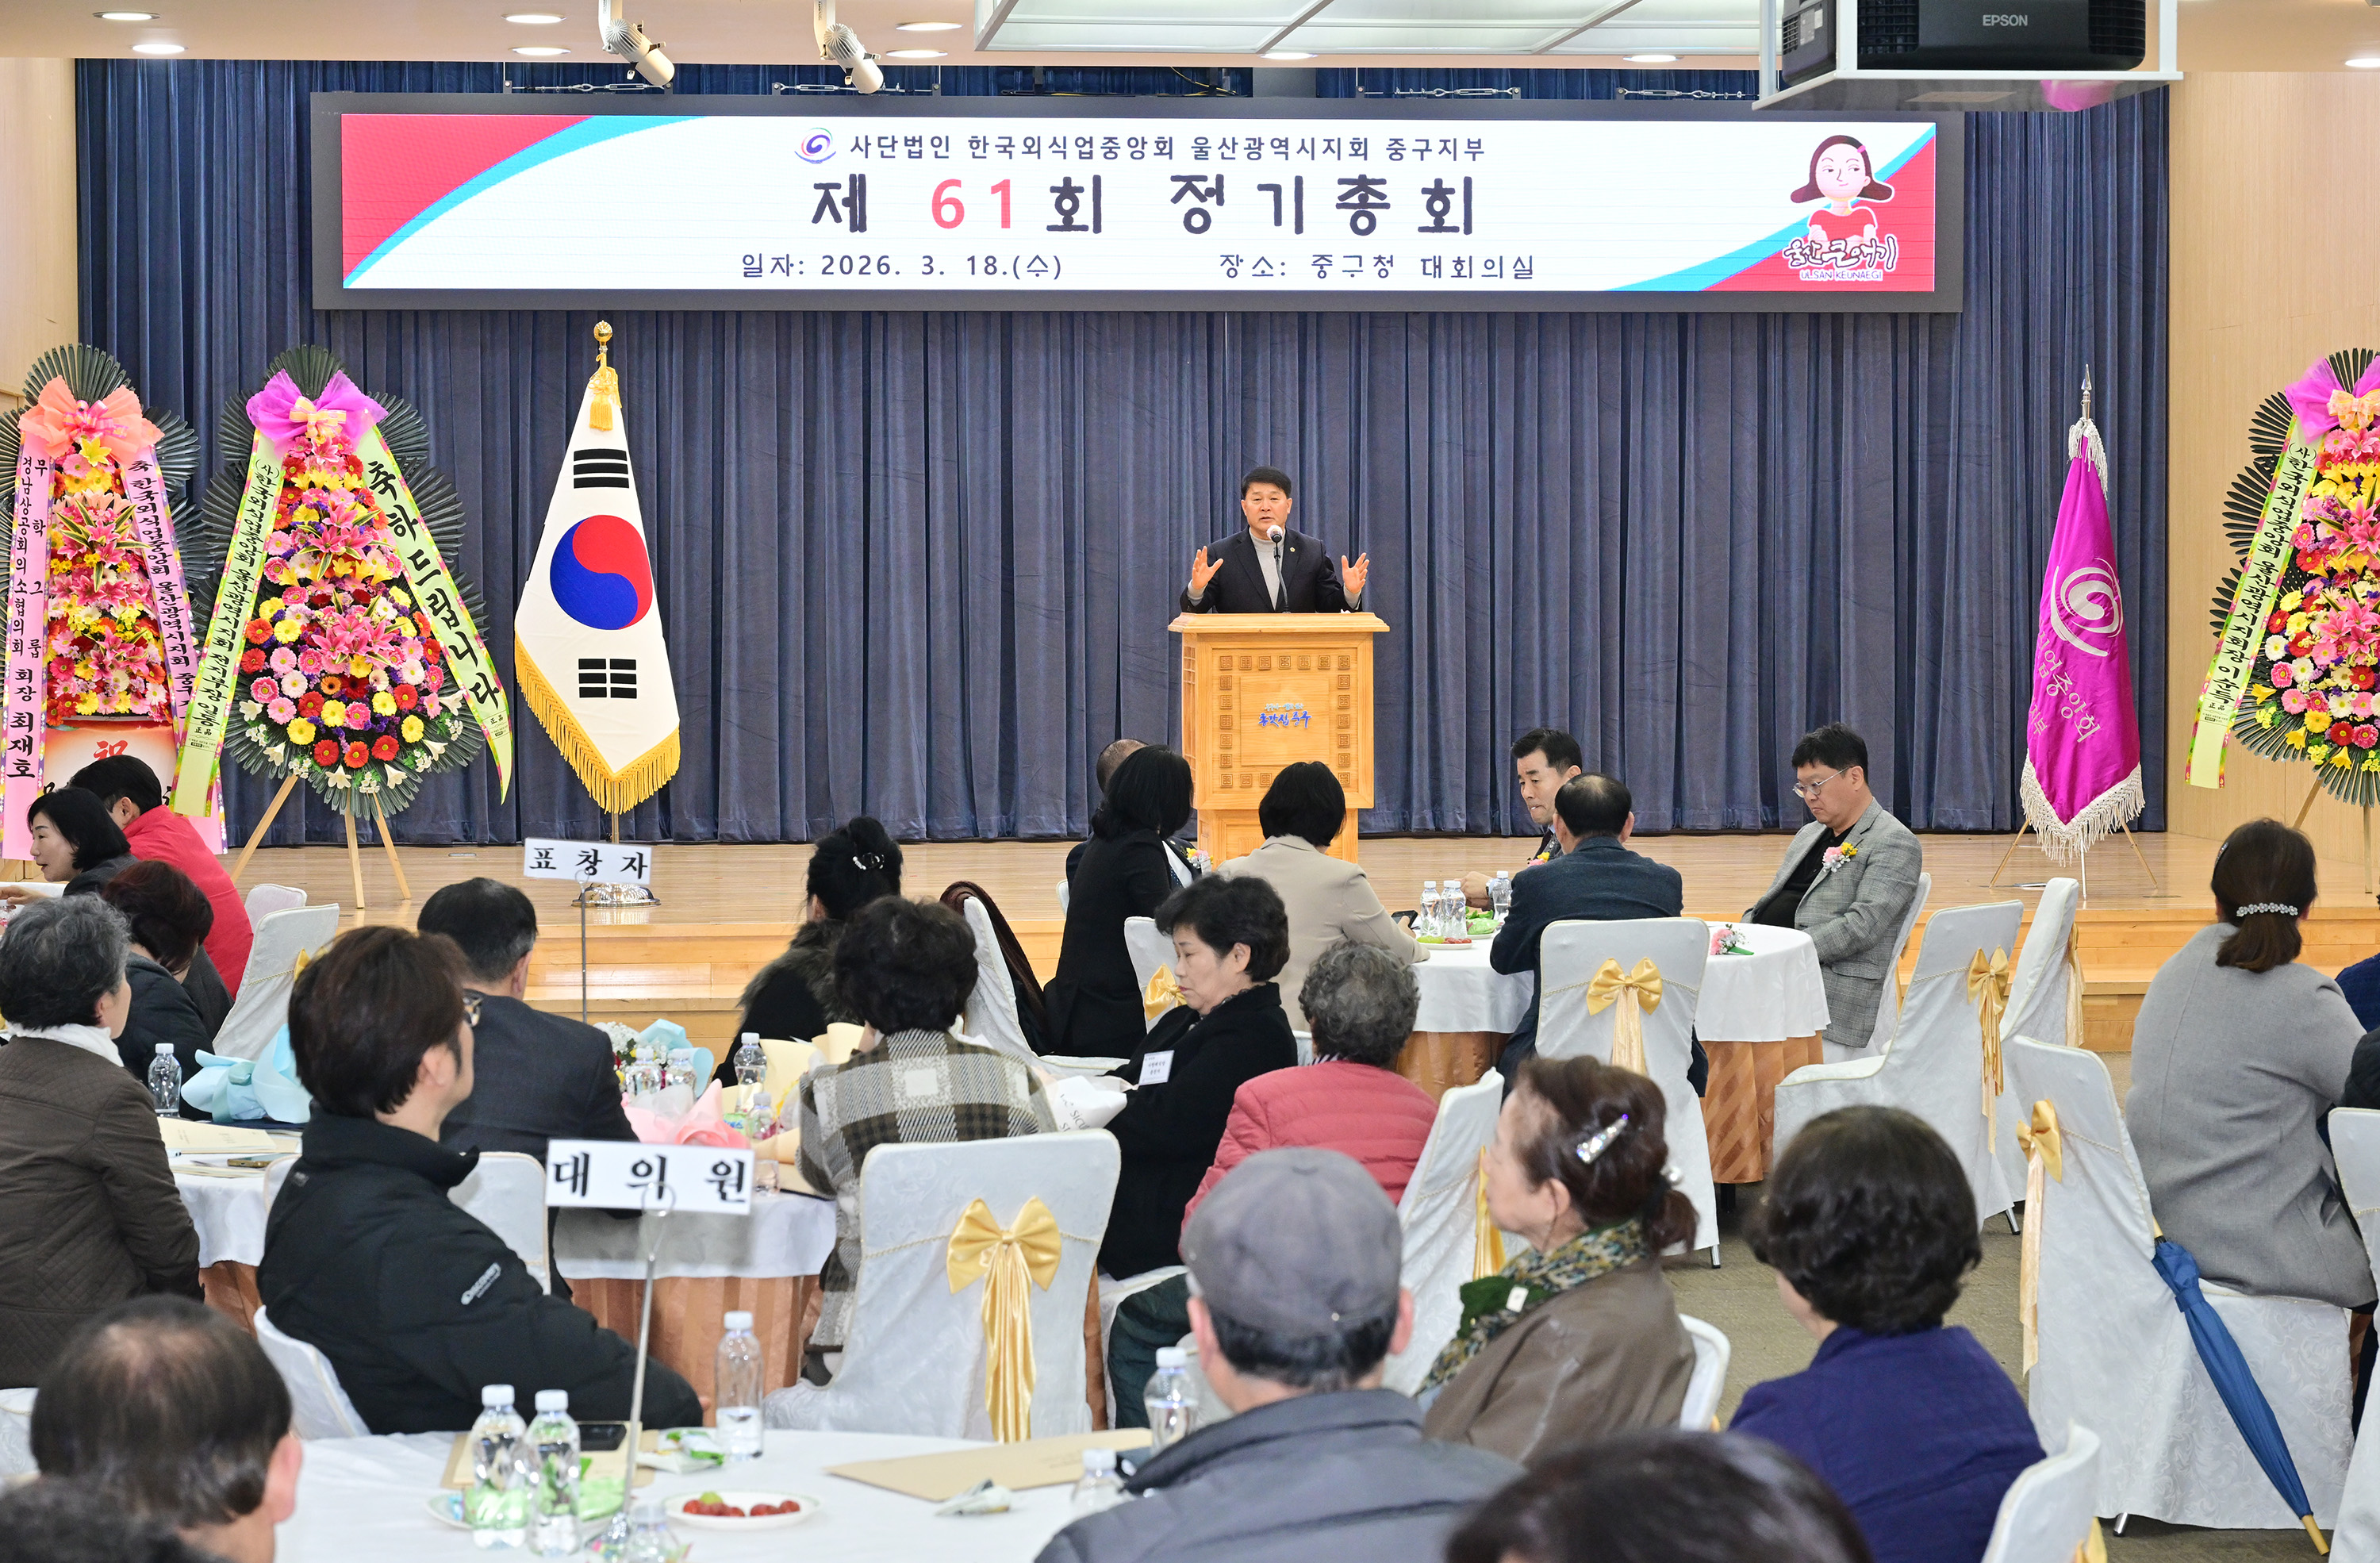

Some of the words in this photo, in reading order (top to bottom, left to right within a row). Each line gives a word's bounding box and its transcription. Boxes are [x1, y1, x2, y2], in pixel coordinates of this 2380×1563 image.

[1983, 14, 2029, 27] EPSON
[850, 135, 950, 159] 사단법인
[968, 136, 1173, 160] 한국외식업중앙회
[1191, 136, 1369, 161] 울산광역시지회
[1386, 138, 1485, 162] 중구지부
[811, 173, 868, 233] 제
[931, 175, 1102, 235] 61회
[1170, 173, 1473, 236] 정기총회
[742, 253, 805, 278] 일자:
[821, 255, 900, 275] 2026.
[921, 255, 945, 275] 3.
[967, 254, 1061, 280] 18.(수)
[1219, 254, 1287, 278] 장소:
[1311, 254, 1395, 279] 중구청
[1420, 255, 1534, 280] 대회의실
[1800, 271, 1833, 280] ULSAN
[1835, 271, 1883, 280] KEUNAEGI
[213, 567, 255, 653] 울산광역시지회
[367, 460, 500, 709] 축하드립니다
[2221, 560, 2279, 664] 울산광역시지회장
[155, 581, 191, 668] 울산광역시지회
[6, 711, 36, 778] 최재호
